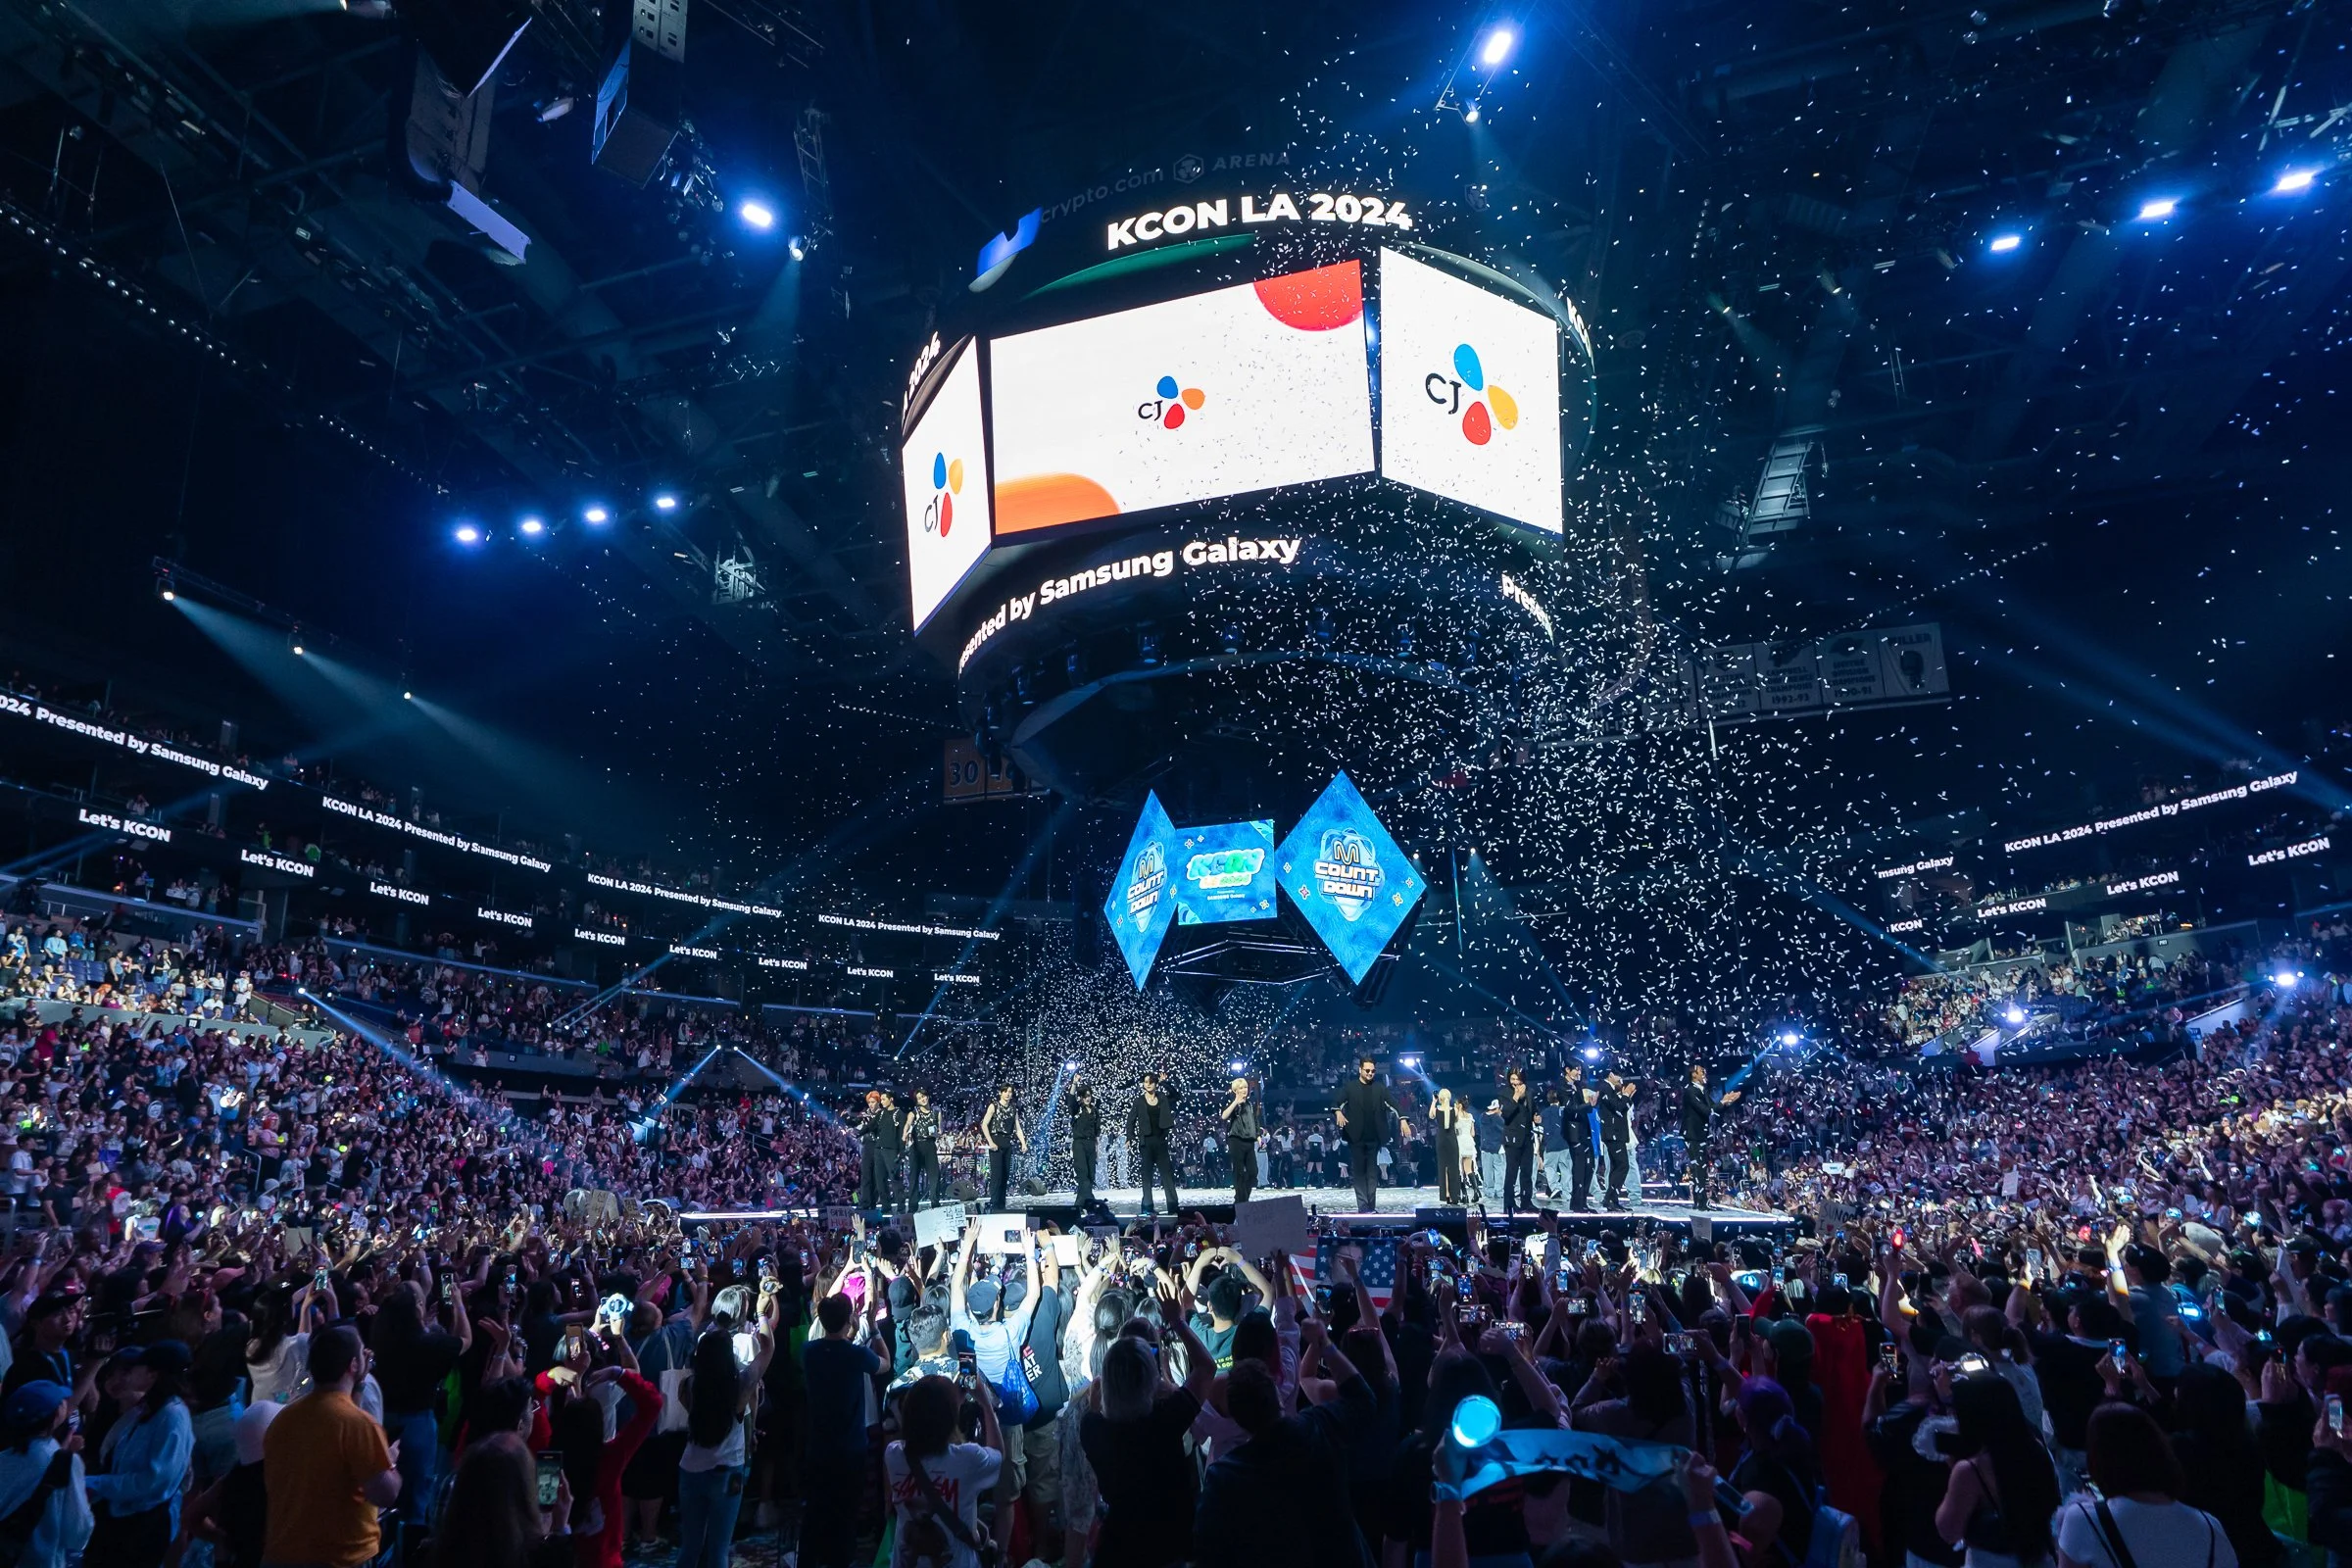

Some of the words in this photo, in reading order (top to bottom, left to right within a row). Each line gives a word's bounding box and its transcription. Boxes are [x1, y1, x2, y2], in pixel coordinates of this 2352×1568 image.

[1042, 168, 1164, 223] crypto.com
[1211, 153, 1291, 172] ARENA
[1107, 198, 1227, 251] KCON
[1241, 194, 1299, 224] LA
[1309, 194, 1413, 230] 2024
[1567, 297, 1594, 372] KCO
[909, 331, 941, 400] 2024
[1425, 372, 1461, 415] CJ
[1138, 400, 1163, 422] CJ
[925, 494, 940, 534] CJ
[958, 604, 1006, 680] esented
[1009, 591, 1037, 621] by
[1040, 551, 1174, 606] Samsung
[1182, 537, 1301, 566] Galaxy
[36, 707, 125, 747] Presented
[127, 734, 150, 754] by
[150, 743, 220, 777] Samsung
[221, 765, 270, 791] Galaxy
[949, 760, 979, 788] 30
[78, 808, 122, 831] Let's
[122, 819, 172, 843] KCON
[2004, 837, 2042, 853] KCON
[2043, 832, 2062, 845] LA
[2062, 825, 2093, 842] 2024
[2094, 807, 2160, 833] Presented
[2162, 802, 2180, 815] by
[2180, 785, 2248, 810] Samsung
[2249, 770, 2299, 794] Galaxy
[322, 796, 358, 816] KCON
[358, 808, 374, 822] LA
[374, 812, 403, 830] 2024
[404, 821, 456, 847] Presented
[457, 834, 470, 852] by
[470, 842, 518, 865] Samsung
[519, 854, 552, 873] Galaxy
[240, 849, 274, 868] Let's
[275, 857, 315, 878] KCON
[2247, 848, 2286, 866] Let's
[2287, 837, 2331, 858] KCON
[1314, 861, 1379, 882] COUNT
[1875, 863, 1916, 879] msung
[1916, 855, 1954, 872] Galaxy
[369, 881, 396, 898] Let's
[398, 888, 429, 906] KCON
[587, 873, 613, 888] KCON
[614, 880, 628, 891] LA
[629, 883, 653, 896] 2024
[654, 887, 700, 905] Presented
[700, 895, 711, 907] by
[711, 898, 751, 914] Samsung
[752, 905, 782, 919] Galaxy
[1127, 869, 1164, 900] COUNT
[1323, 880, 1374, 899] DOWN
[2106, 880, 2138, 897] Let's
[2139, 870, 2180, 889] KCON
[1130, 890, 1159, 914] DOWN
[1977, 904, 2007, 919] Let's
[2008, 898, 2047, 913] KCON
[477, 907, 503, 921] Let's
[504, 912, 532, 928] KCON
[817, 913, 843, 925] KCON
[843, 917, 856, 927] LA
[856, 918, 876, 930] 2024
[877, 922, 921, 933] Presented
[921, 924, 934, 936] by
[934, 926, 972, 939] Samsung
[972, 928, 1001, 941] Galaxy
[1889, 918, 1924, 933] KCON
[574, 928, 597, 941] Let's
[597, 932, 625, 946] KCON
[668, 944, 692, 956] Let's
[692, 948, 717, 959] KCON
[758, 956, 781, 968] Let's
[781, 959, 808, 971] KCON
[847, 965, 868, 977] Let's
[868, 967, 894, 978] KCON
[934, 972, 955, 983] Let's
[955, 974, 980, 984] KCON
